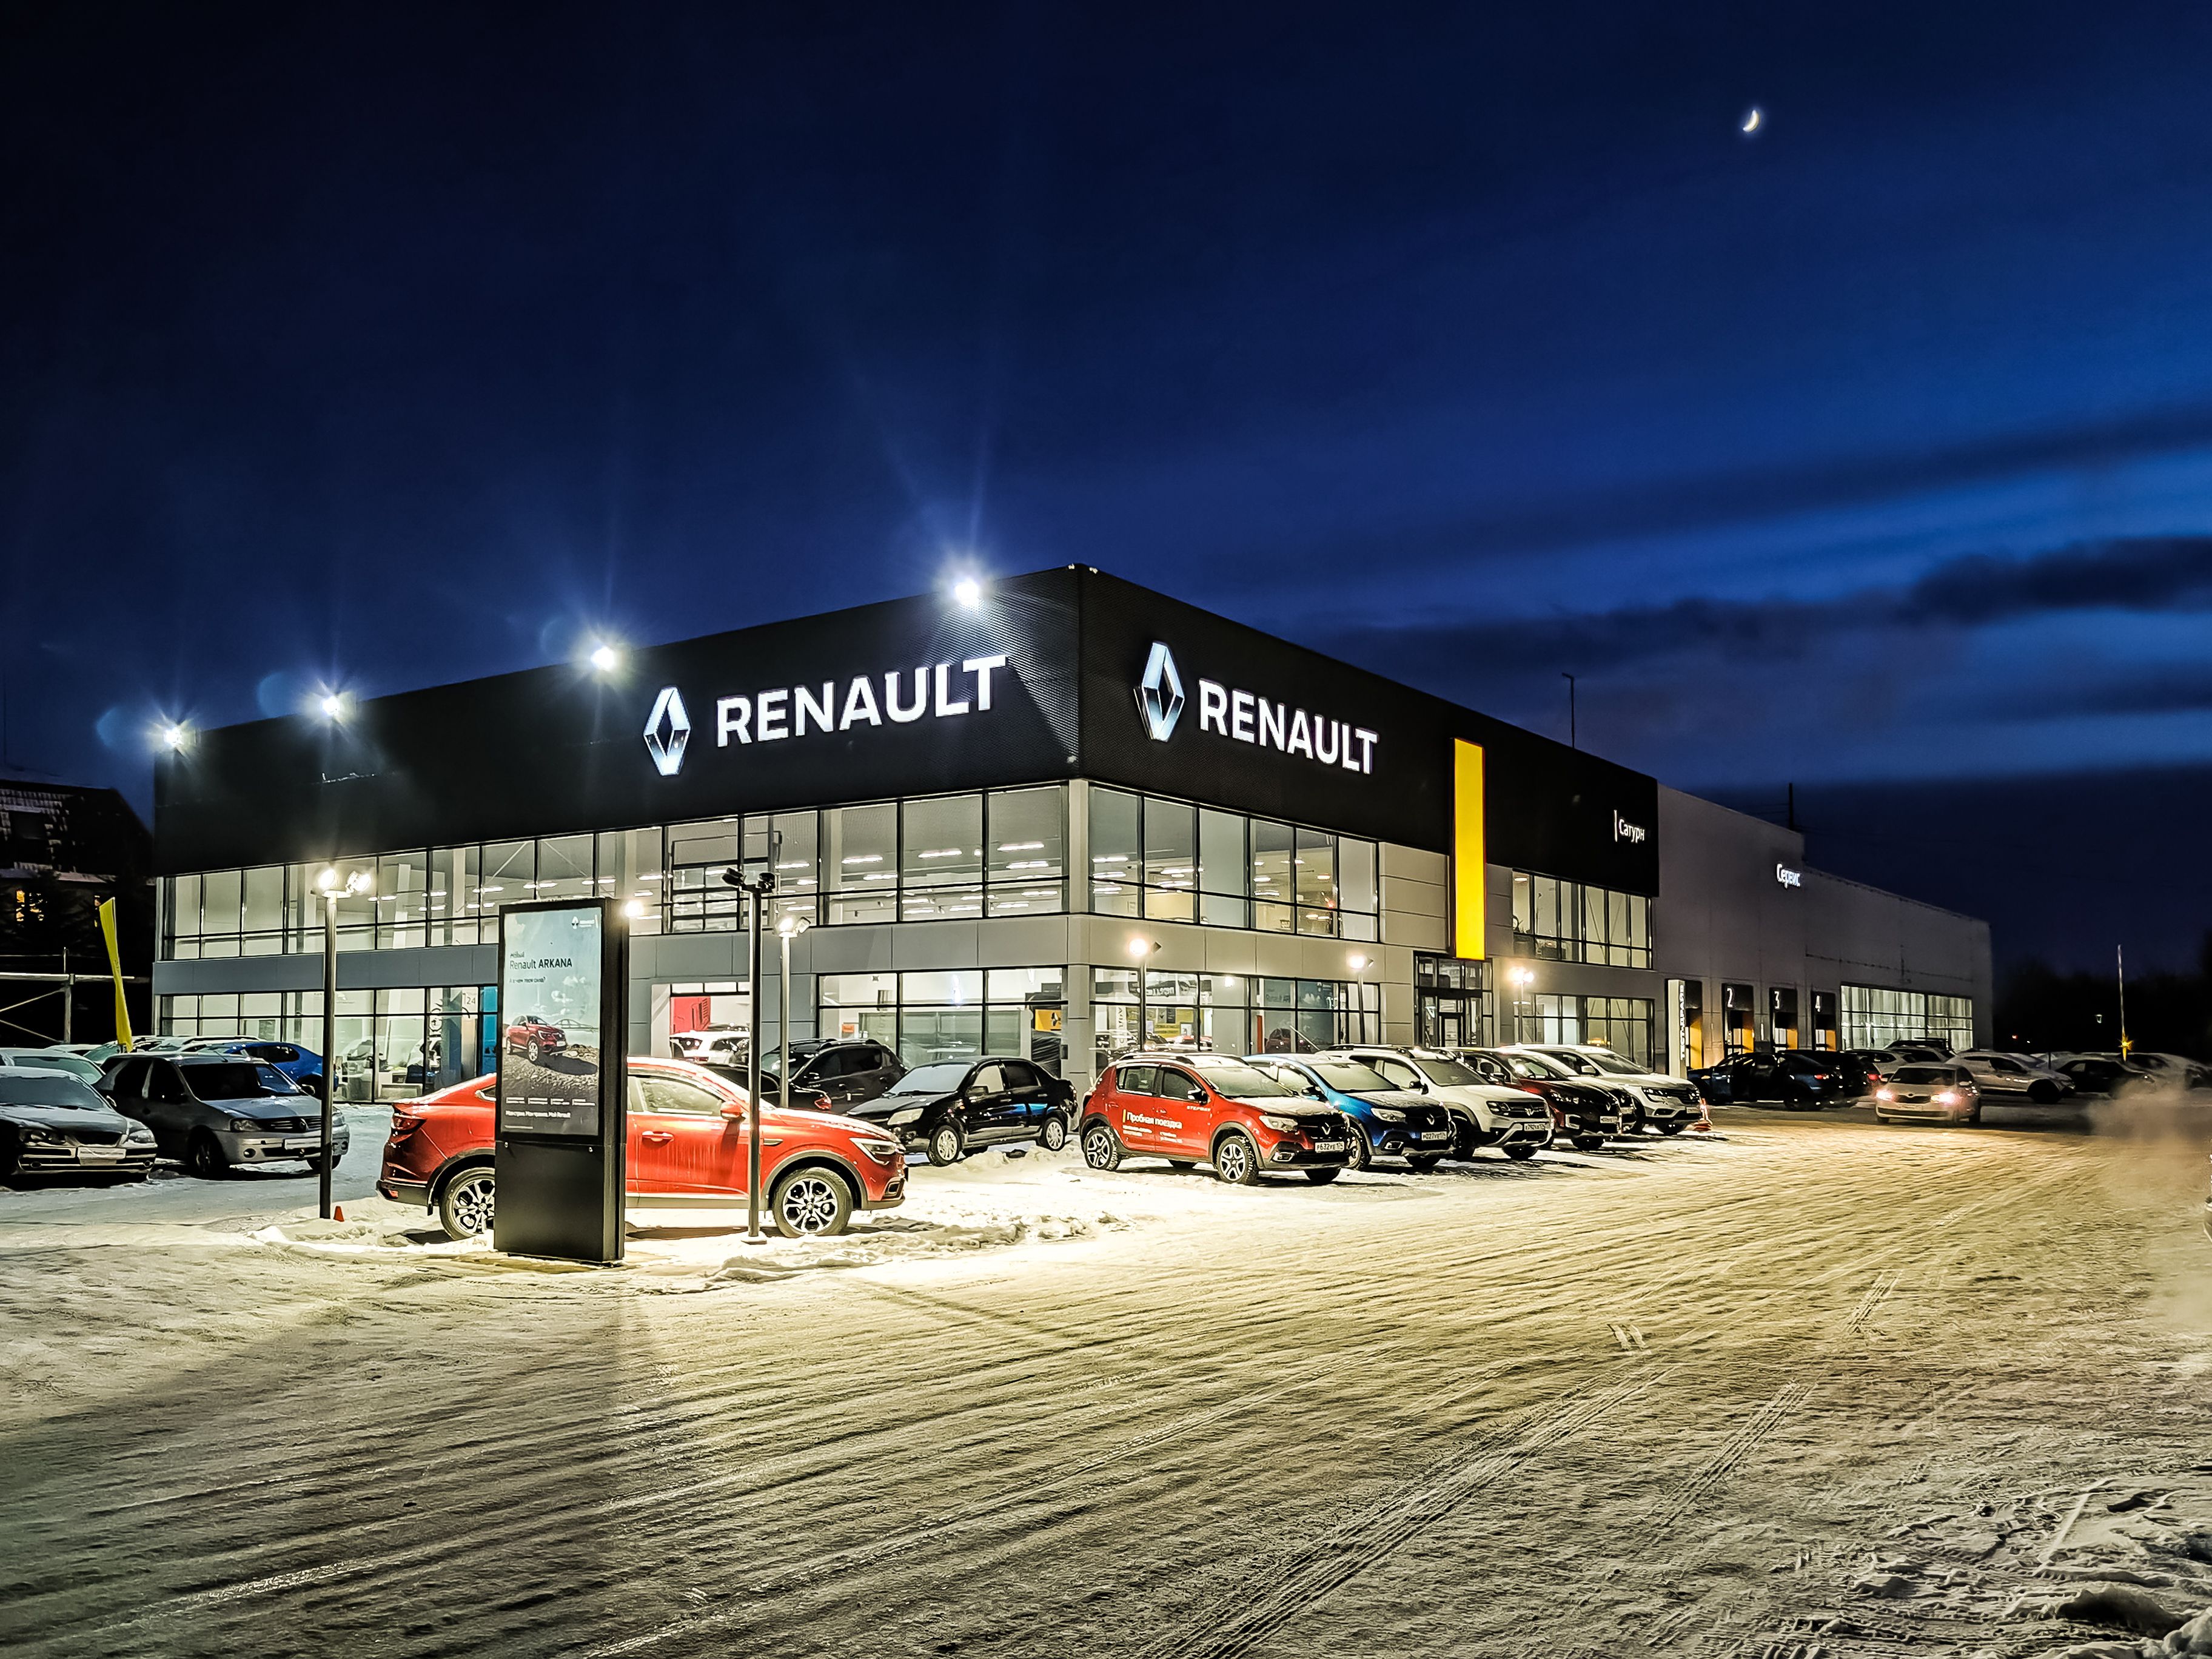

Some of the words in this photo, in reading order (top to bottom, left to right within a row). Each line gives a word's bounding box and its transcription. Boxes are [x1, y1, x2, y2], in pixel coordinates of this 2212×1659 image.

[716, 654, 1009, 748] RENAULT
[1199, 678, 1378, 775] RENAULT
[1618, 819, 1644, 843] Сатурн
[1777, 863, 1800, 889] Сервис
[509, 959, 537, 970] Renault
[538, 958, 572, 968] ARKANA
[1726, 988, 1733, 1008] 2
[1774, 991, 1780, 1009] 3
[1815, 995, 1821, 1012] 4
[1127, 1111, 1155, 1125] Пробная
[1155, 1118, 1182, 1129] поездка
